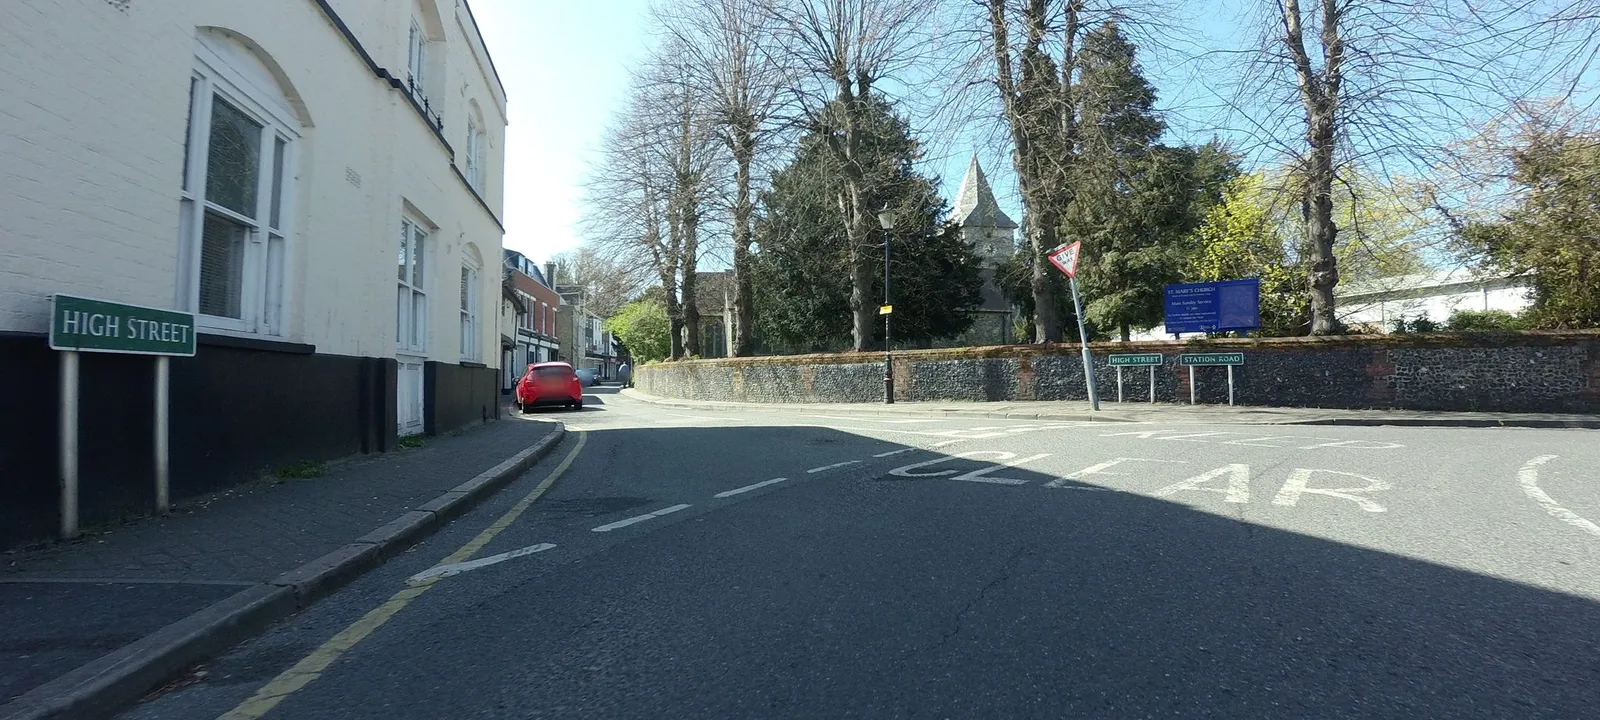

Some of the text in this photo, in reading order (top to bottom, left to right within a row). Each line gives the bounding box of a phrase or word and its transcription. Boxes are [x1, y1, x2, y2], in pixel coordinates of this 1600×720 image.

[1056, 248, 1074, 262] GIVE
[62, 310, 190, 344] HIGH STREET
[888, 450, 1391, 514] CLEAR
